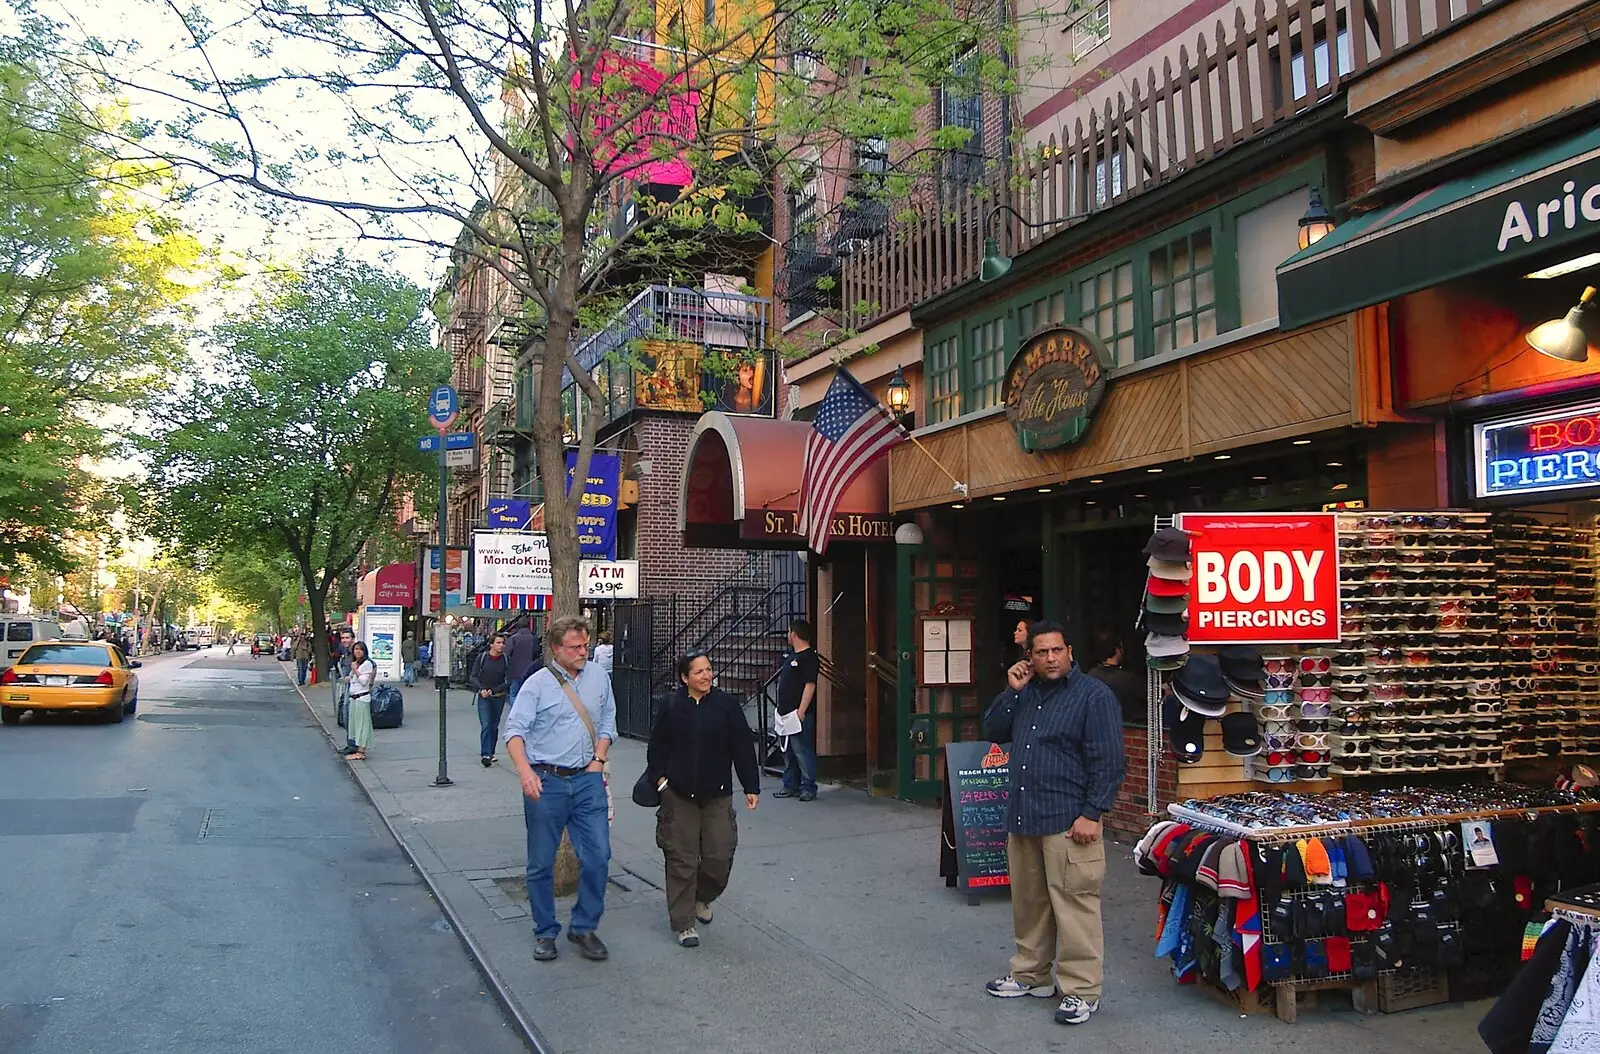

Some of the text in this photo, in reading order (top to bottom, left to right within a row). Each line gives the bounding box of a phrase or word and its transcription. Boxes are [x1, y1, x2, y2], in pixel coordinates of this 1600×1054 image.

[1045, 378, 1089, 422] House
[420, 439, 432, 449] M8
[1531, 412, 1600, 451] BO
[1489, 450, 1600, 488] PIER
[764, 511, 788, 533] ST.
[848, 514, 895, 537] HOTEL
[511, 543, 533, 554] The
[589, 567, 624, 578] ATM
[1197, 550, 1325, 604] BODY
[1198, 609, 1327, 628] PIERCINGS
